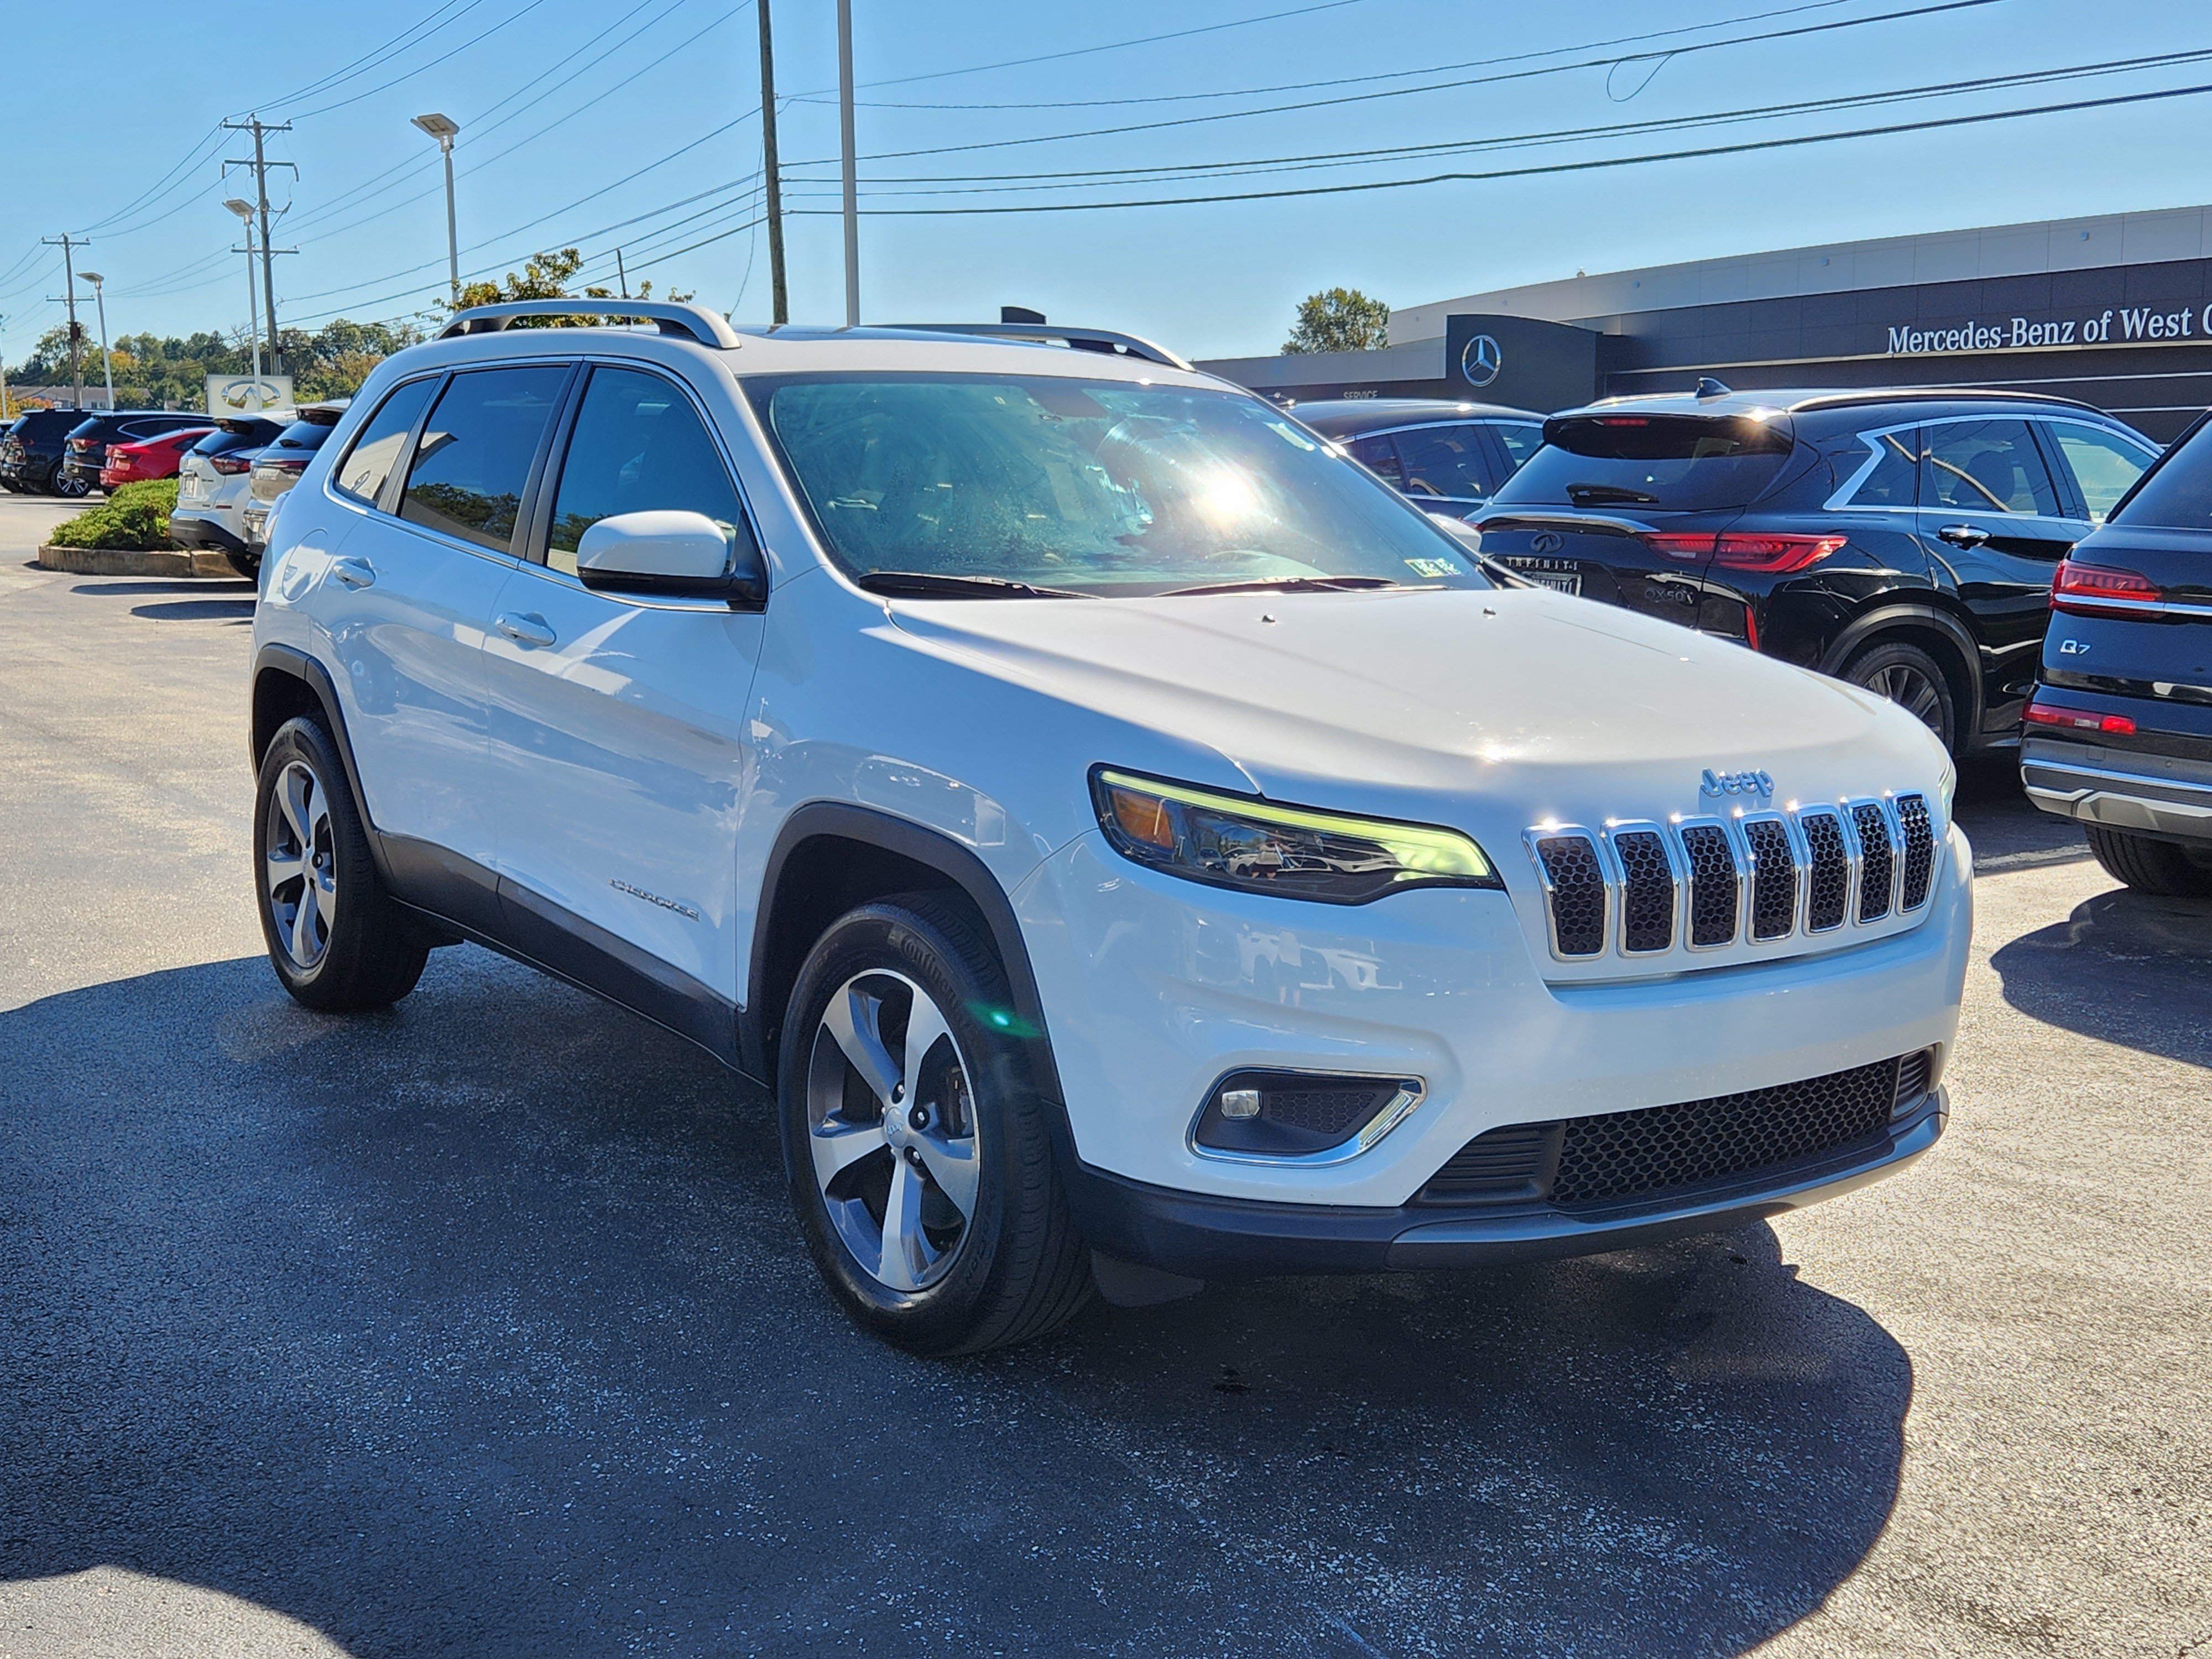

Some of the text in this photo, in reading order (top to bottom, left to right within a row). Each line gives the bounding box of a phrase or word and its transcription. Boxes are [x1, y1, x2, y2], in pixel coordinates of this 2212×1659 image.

[1886, 317, 2075, 354] Mercedes-Benz
[2084, 310, 2112, 342] of
[2120, 307, 2193, 340] West
[1343, 390, 1378, 399] SERVICE
[2060, 639, 2091, 655] Q7
[1699, 767, 1775, 797] Jeep
